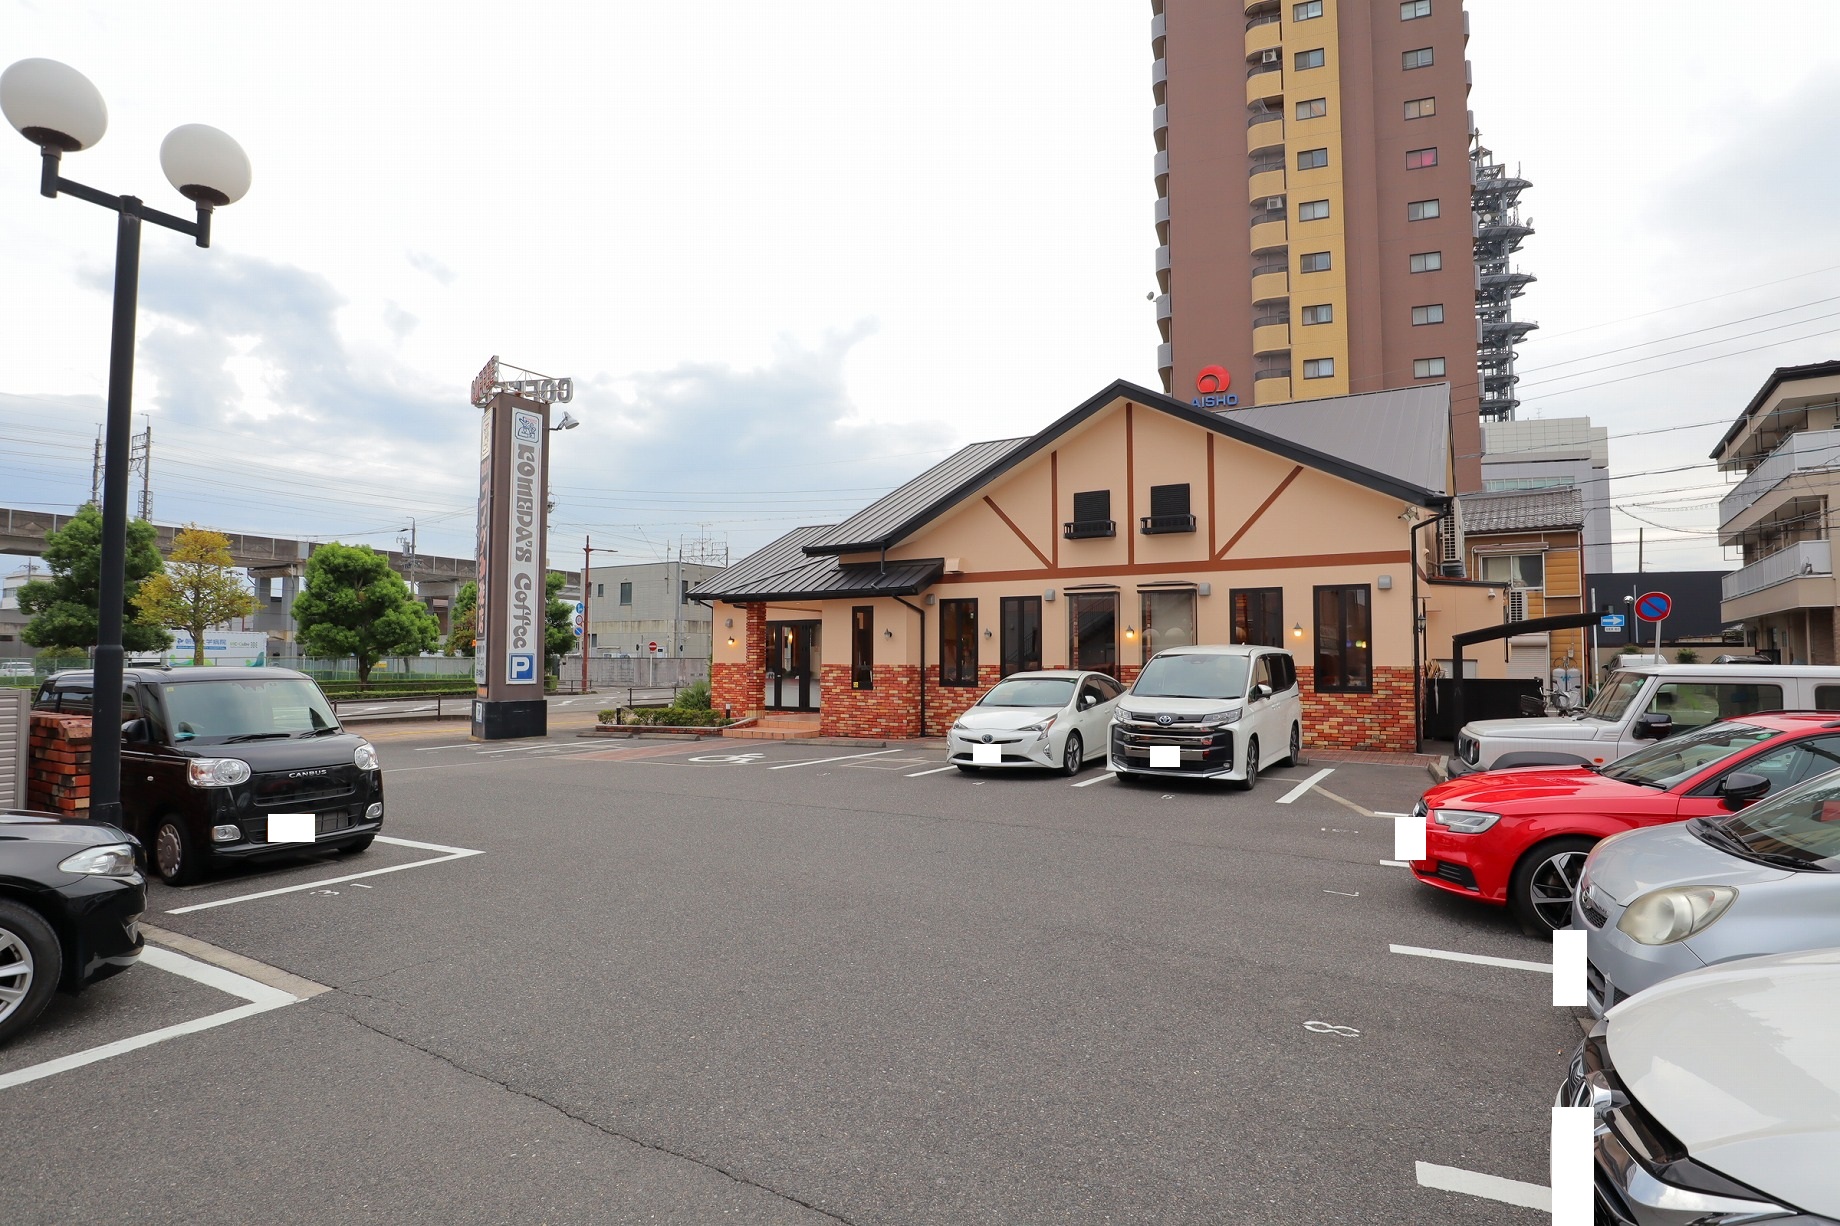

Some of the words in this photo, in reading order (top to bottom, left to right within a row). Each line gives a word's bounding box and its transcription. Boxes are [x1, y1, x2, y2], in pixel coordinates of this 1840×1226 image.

[1191, 394, 1239, 408] AISHO
[515, 443, 536, 563] KOMEDA'S
[512, 572, 532, 650] Coffee
[511, 656, 530, 679] P
[288, 769, 327, 779] CANBUS
